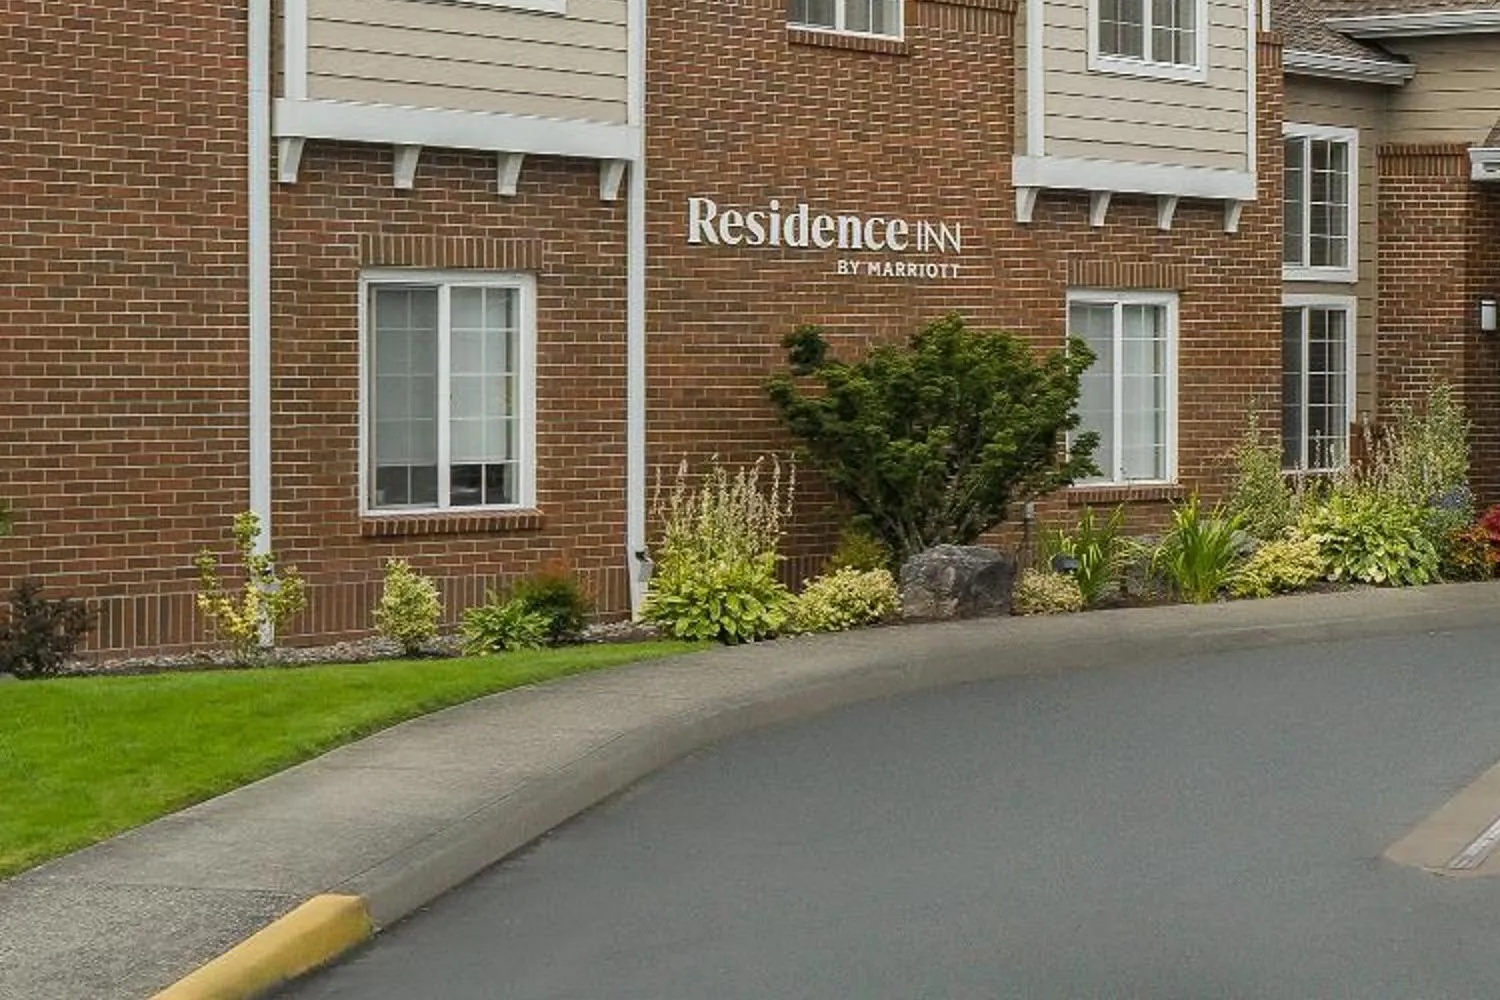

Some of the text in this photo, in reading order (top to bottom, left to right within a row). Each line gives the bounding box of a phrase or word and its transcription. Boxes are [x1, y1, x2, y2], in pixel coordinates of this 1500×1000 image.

[687, 196, 962, 255] Residence INN
[837, 258, 962, 279] BY MARRIOTT
